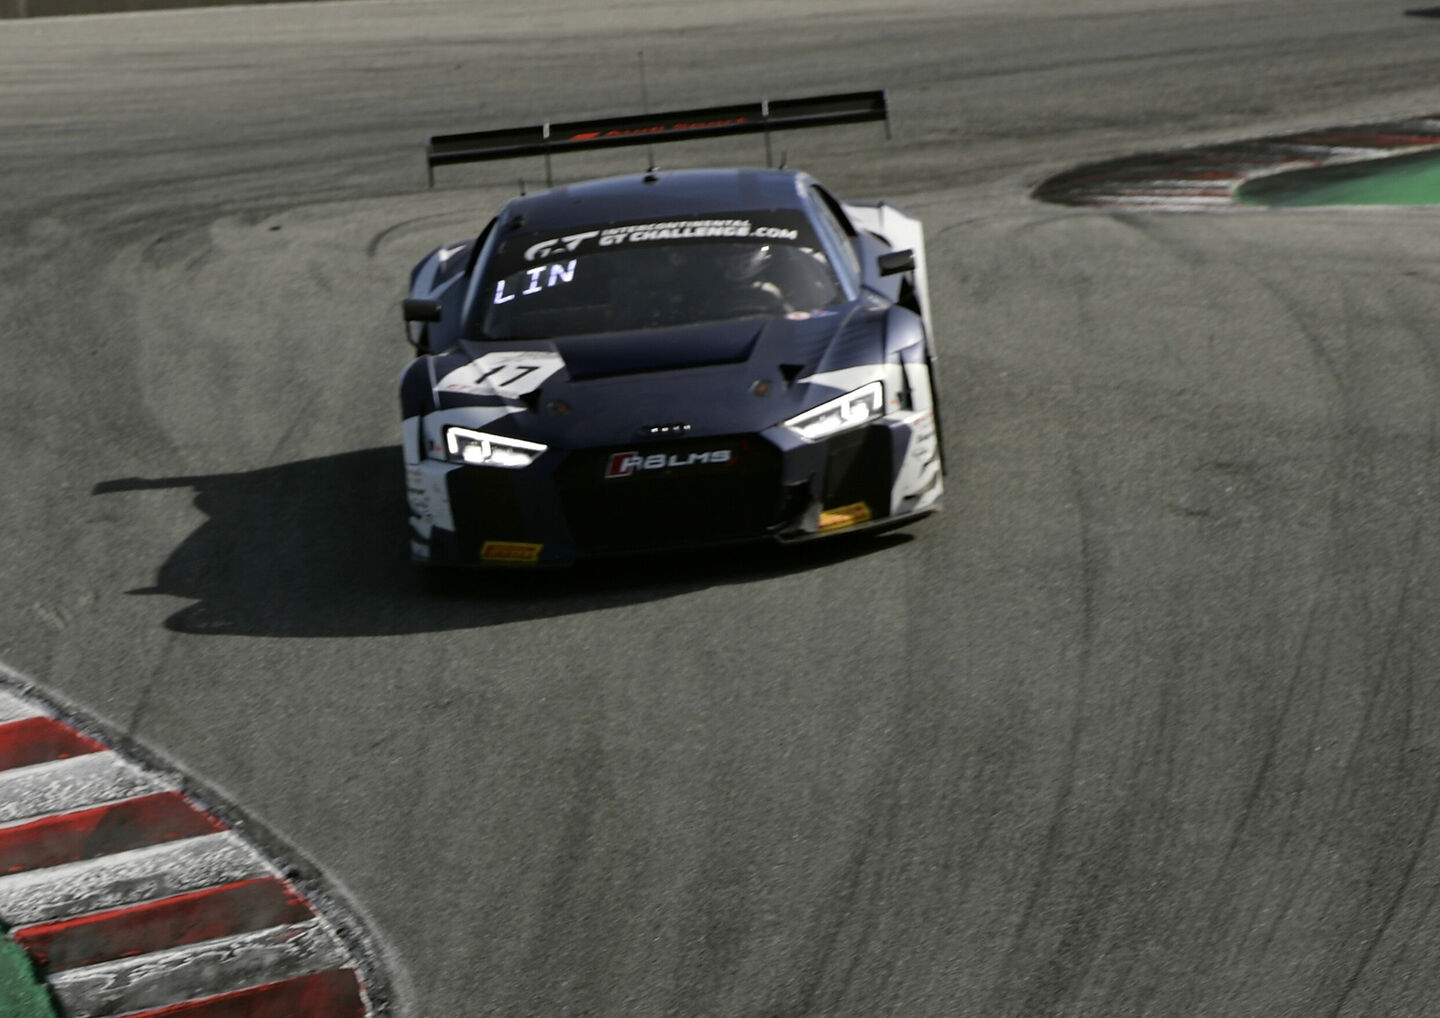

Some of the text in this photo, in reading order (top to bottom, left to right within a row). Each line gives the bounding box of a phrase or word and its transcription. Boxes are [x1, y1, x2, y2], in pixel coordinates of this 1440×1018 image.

[598, 225, 798, 247] GT CHALLENGE.COM
[600, 219, 751, 237] INTERCONTINENTAL
[493, 259, 577, 304] LIN
[474, 365, 541, 387] 17
